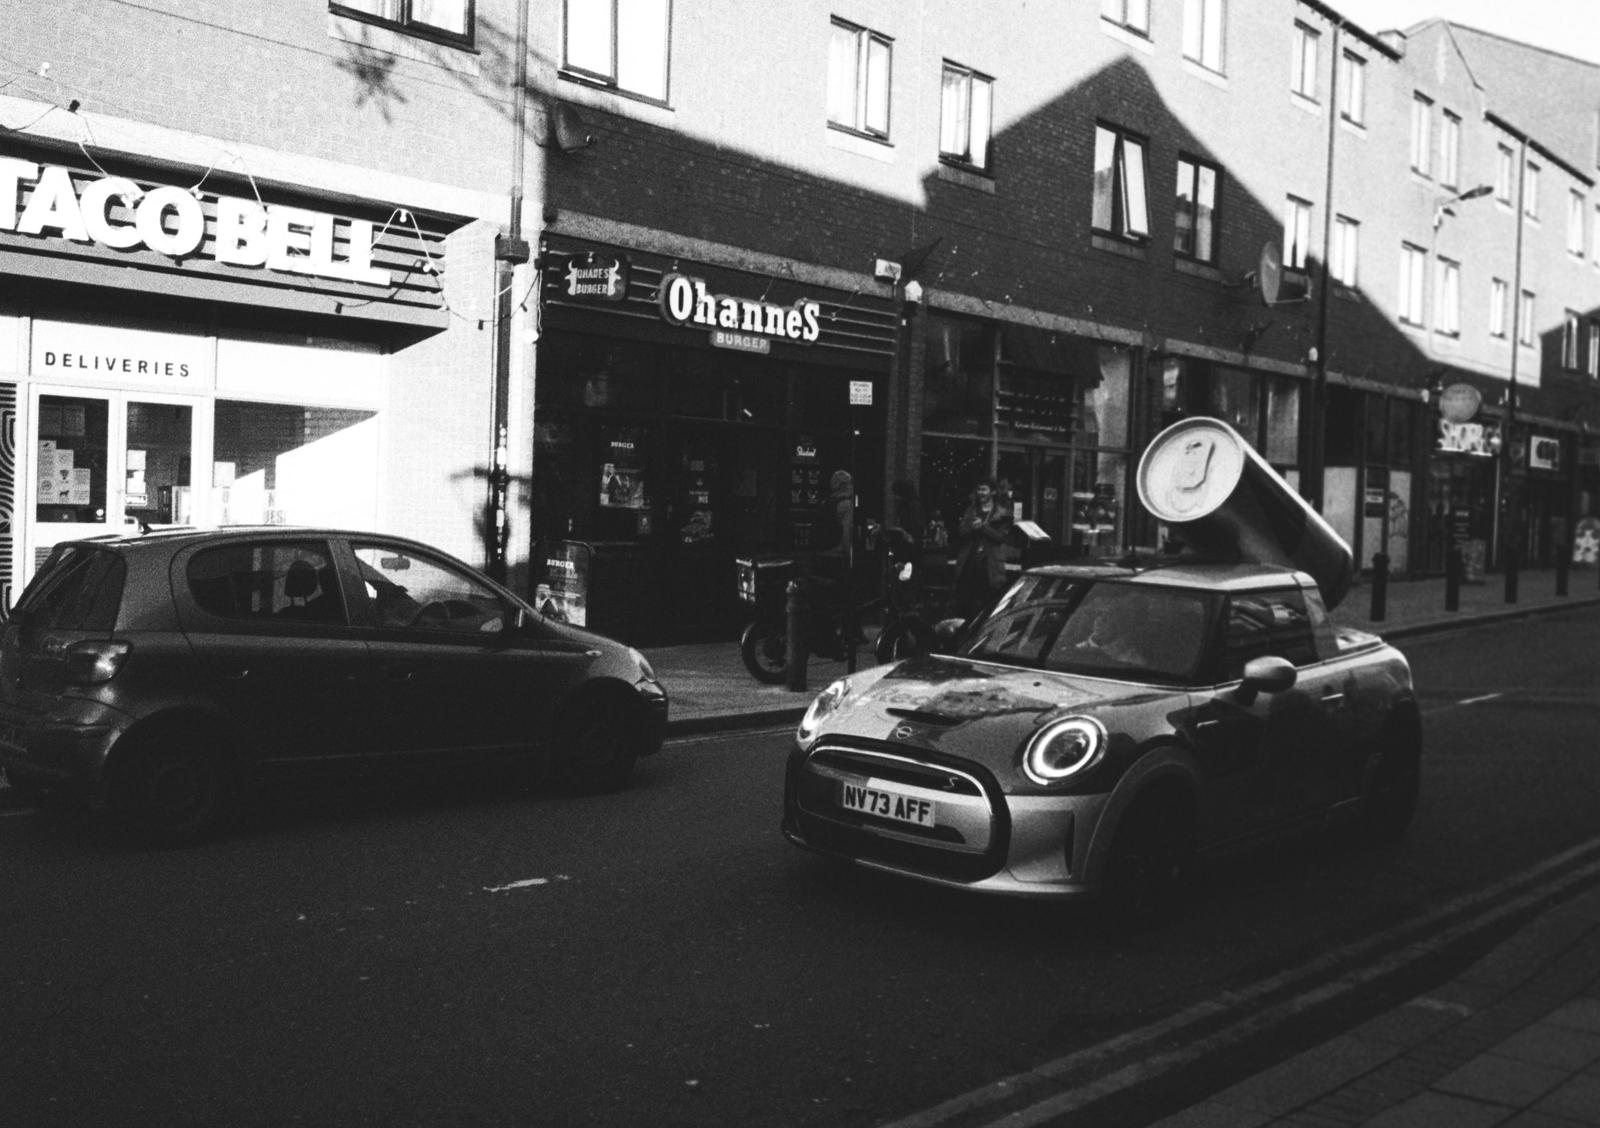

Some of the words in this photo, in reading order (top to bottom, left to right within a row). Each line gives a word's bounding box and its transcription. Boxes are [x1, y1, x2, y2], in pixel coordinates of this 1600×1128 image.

[0, 156, 205, 256] TACO
[215, 196, 392, 286] BELL
[576, 283, 608, 295] BURGER
[717, 332, 768, 350] BURGER
[45, 351, 190, 378] DELIVERIES
[546, 559, 574, 569] BURGER
[844, 785, 890, 815] NV73
[894, 796, 931, 823] AFF
